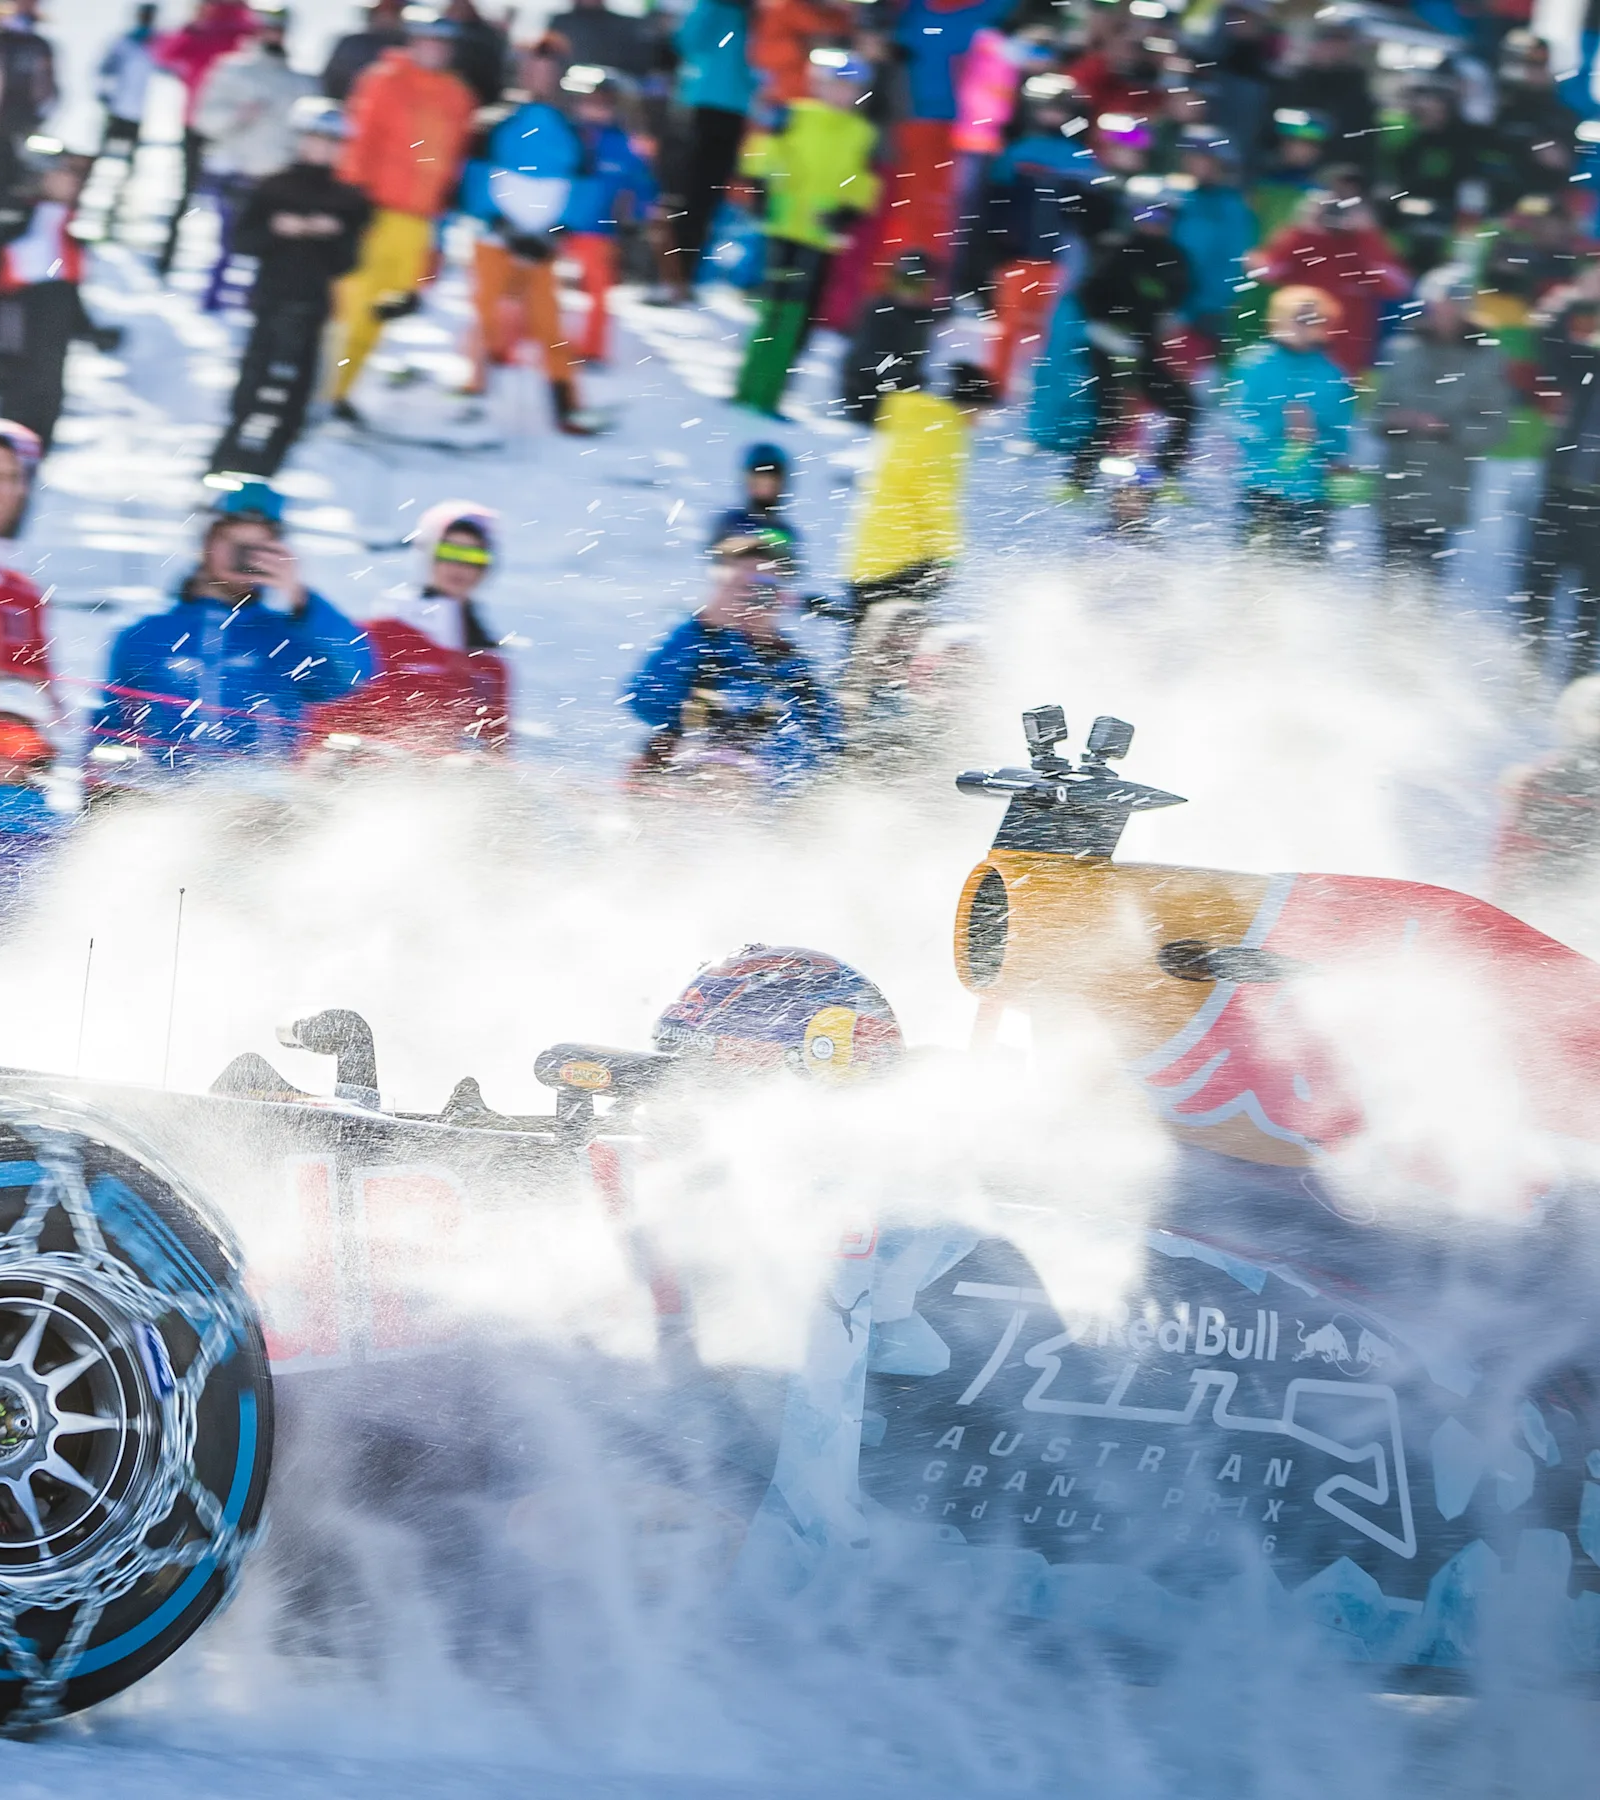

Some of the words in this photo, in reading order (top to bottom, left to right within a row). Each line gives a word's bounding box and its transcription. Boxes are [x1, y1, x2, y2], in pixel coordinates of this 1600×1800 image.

[934, 1425, 1293, 1488] AUSTRIAN
[923, 1460, 1119, 1502] GRAND
[1161, 1487, 1285, 1523] PRIX
[911, 1494, 988, 1519] 3rd
[1172, 1524, 1277, 1554] 206
